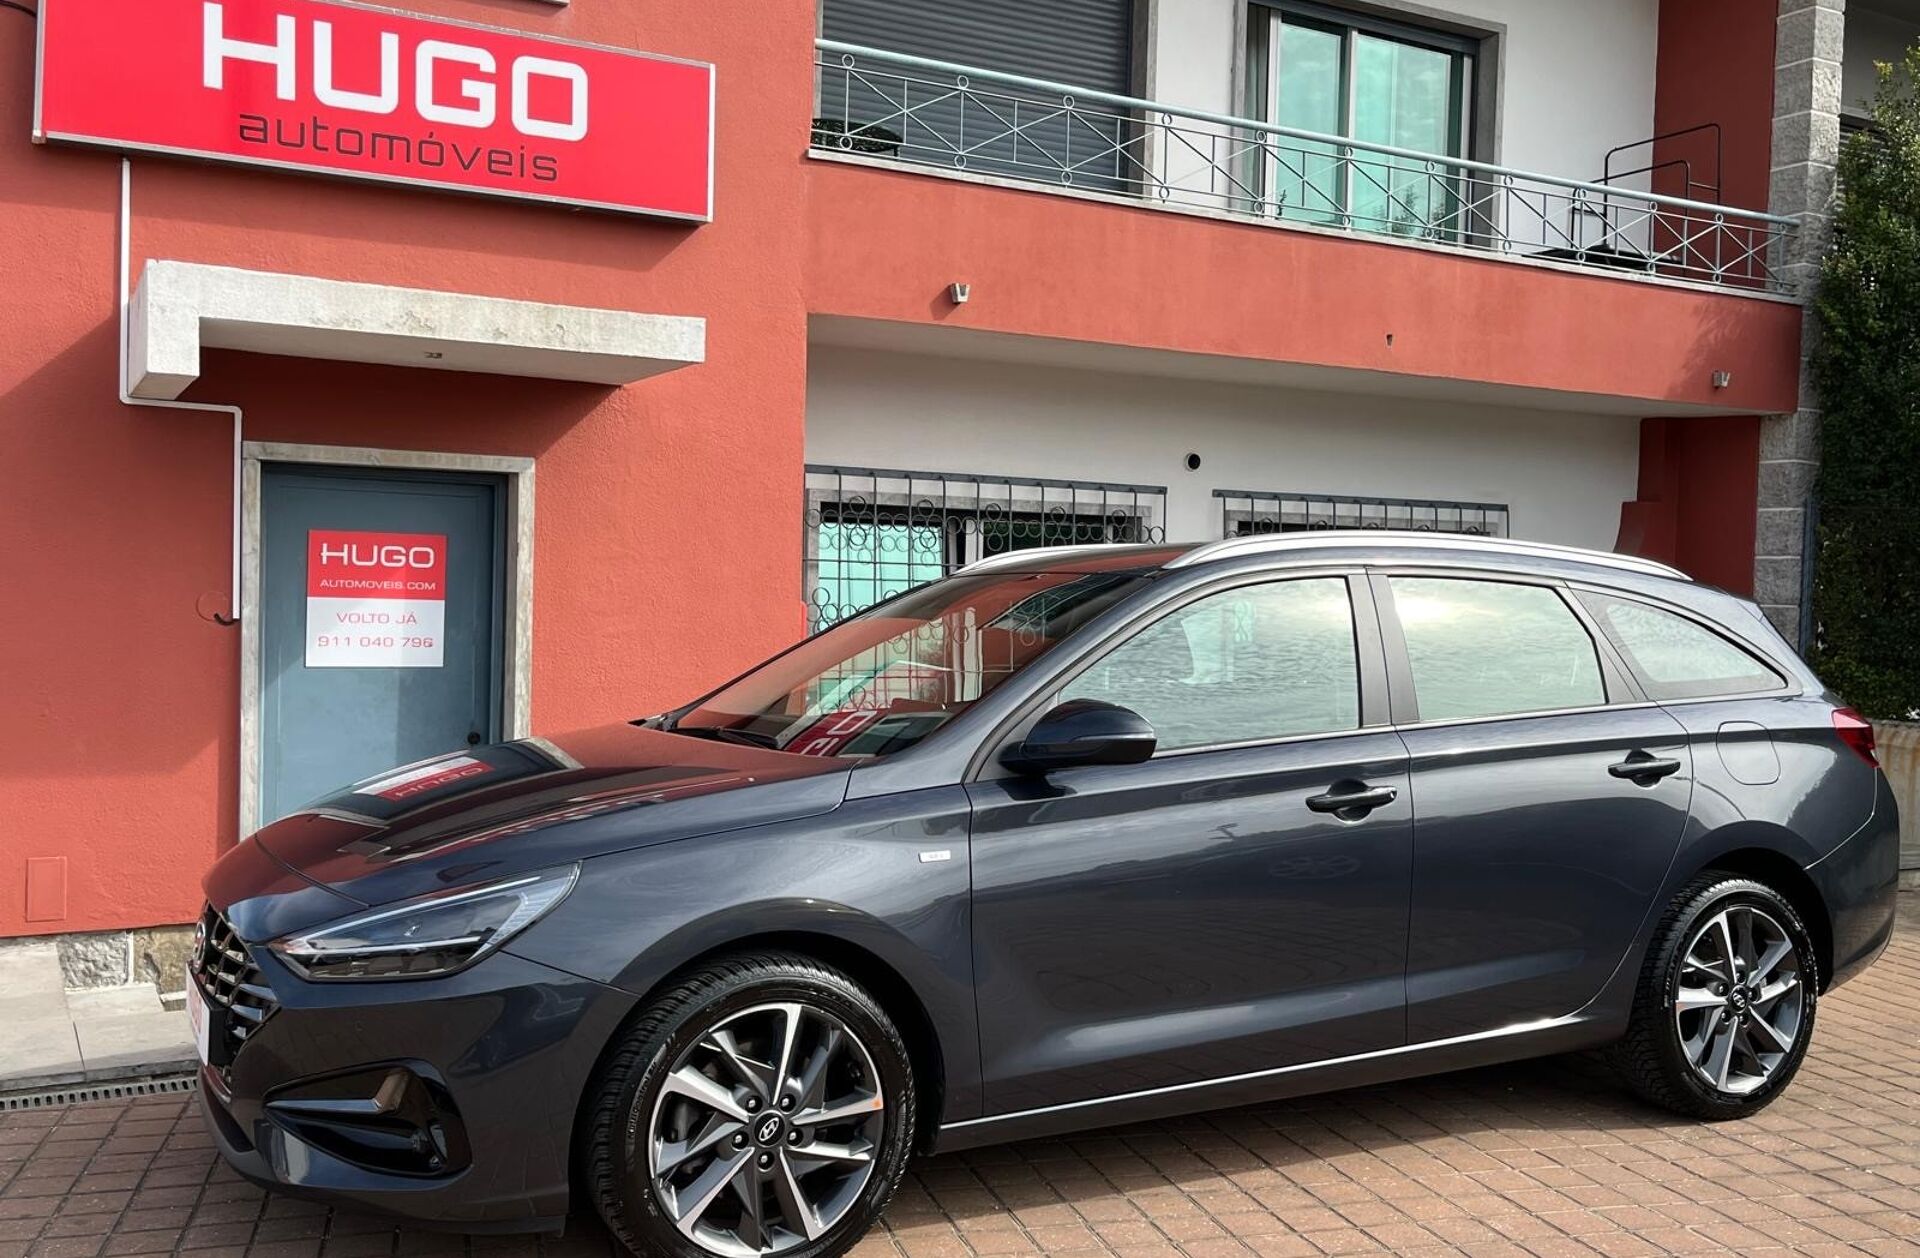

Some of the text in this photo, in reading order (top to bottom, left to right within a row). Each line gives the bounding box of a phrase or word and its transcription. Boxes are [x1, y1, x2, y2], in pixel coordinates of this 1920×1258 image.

[203, 2, 589, 142] HUGO
[239, 113, 559, 183] automóveis
[320, 542, 435, 569] HUGO
[336, 609, 418, 625] VOLTO JÁ
[317, 635, 351, 648] 911
[359, 636, 394, 648] 040
